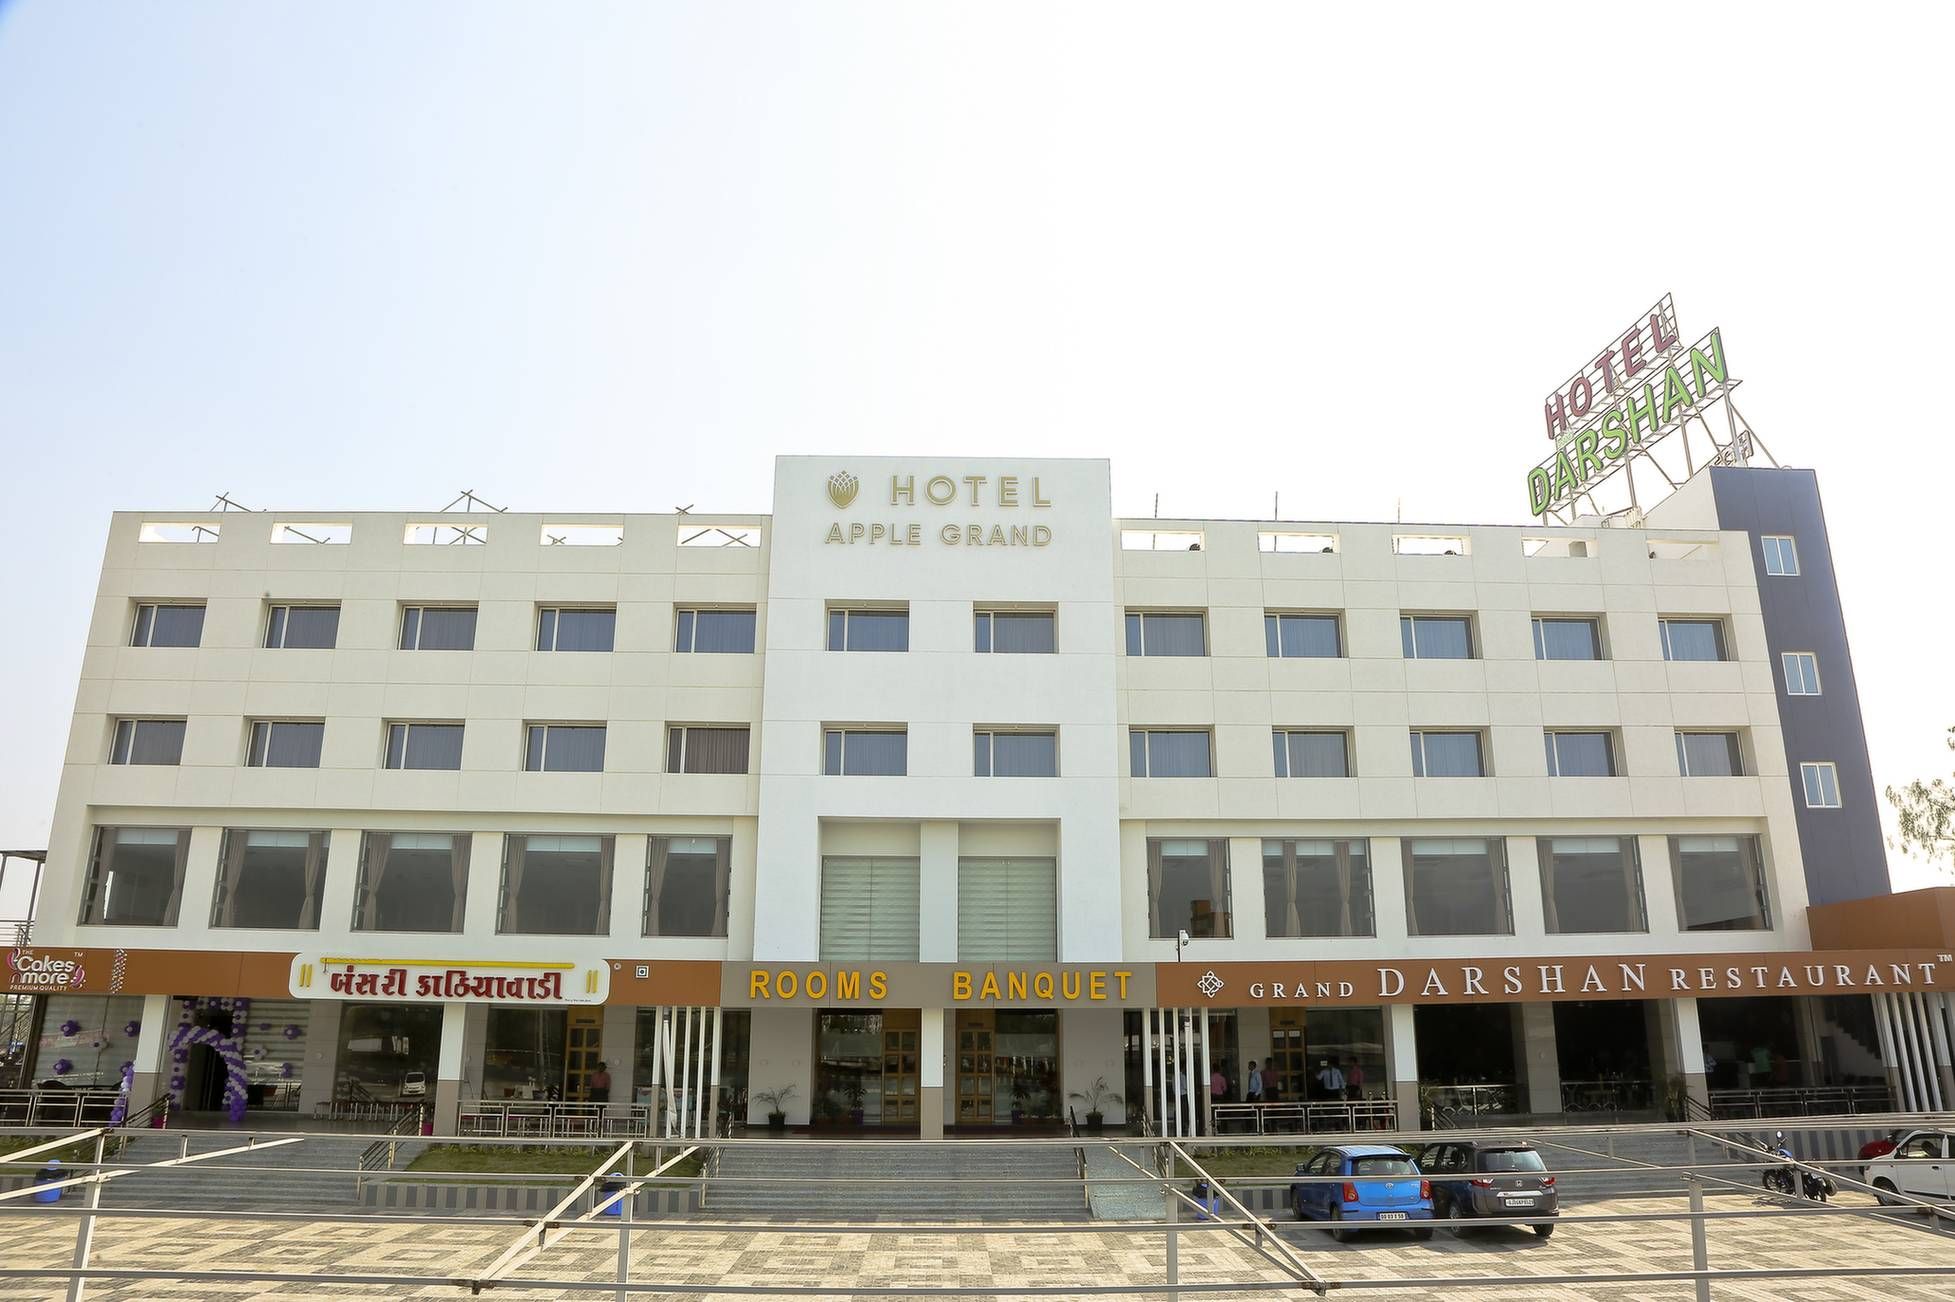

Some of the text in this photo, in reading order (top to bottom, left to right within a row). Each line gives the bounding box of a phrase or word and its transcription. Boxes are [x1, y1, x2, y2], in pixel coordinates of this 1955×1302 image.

[1544, 313, 1677, 440] HOTEL
[1527, 332, 1728, 517] DARSHAN
[889, 474, 1052, 507] HOTEL
[824, 521, 1053, 547] APPLE GRAND
[17, 954, 75, 972] Cakes
[1249, 953, 1953, 999] GRAND DARSHAN RESTAURANT TM
[39, 984, 68, 992] QUALITY
[330, 964, 563, 1000] બંસરી કાઠિયાવાડી
[749, 969, 890, 1000] ROOMS
[952, 970, 1133, 1001] BANQUET
